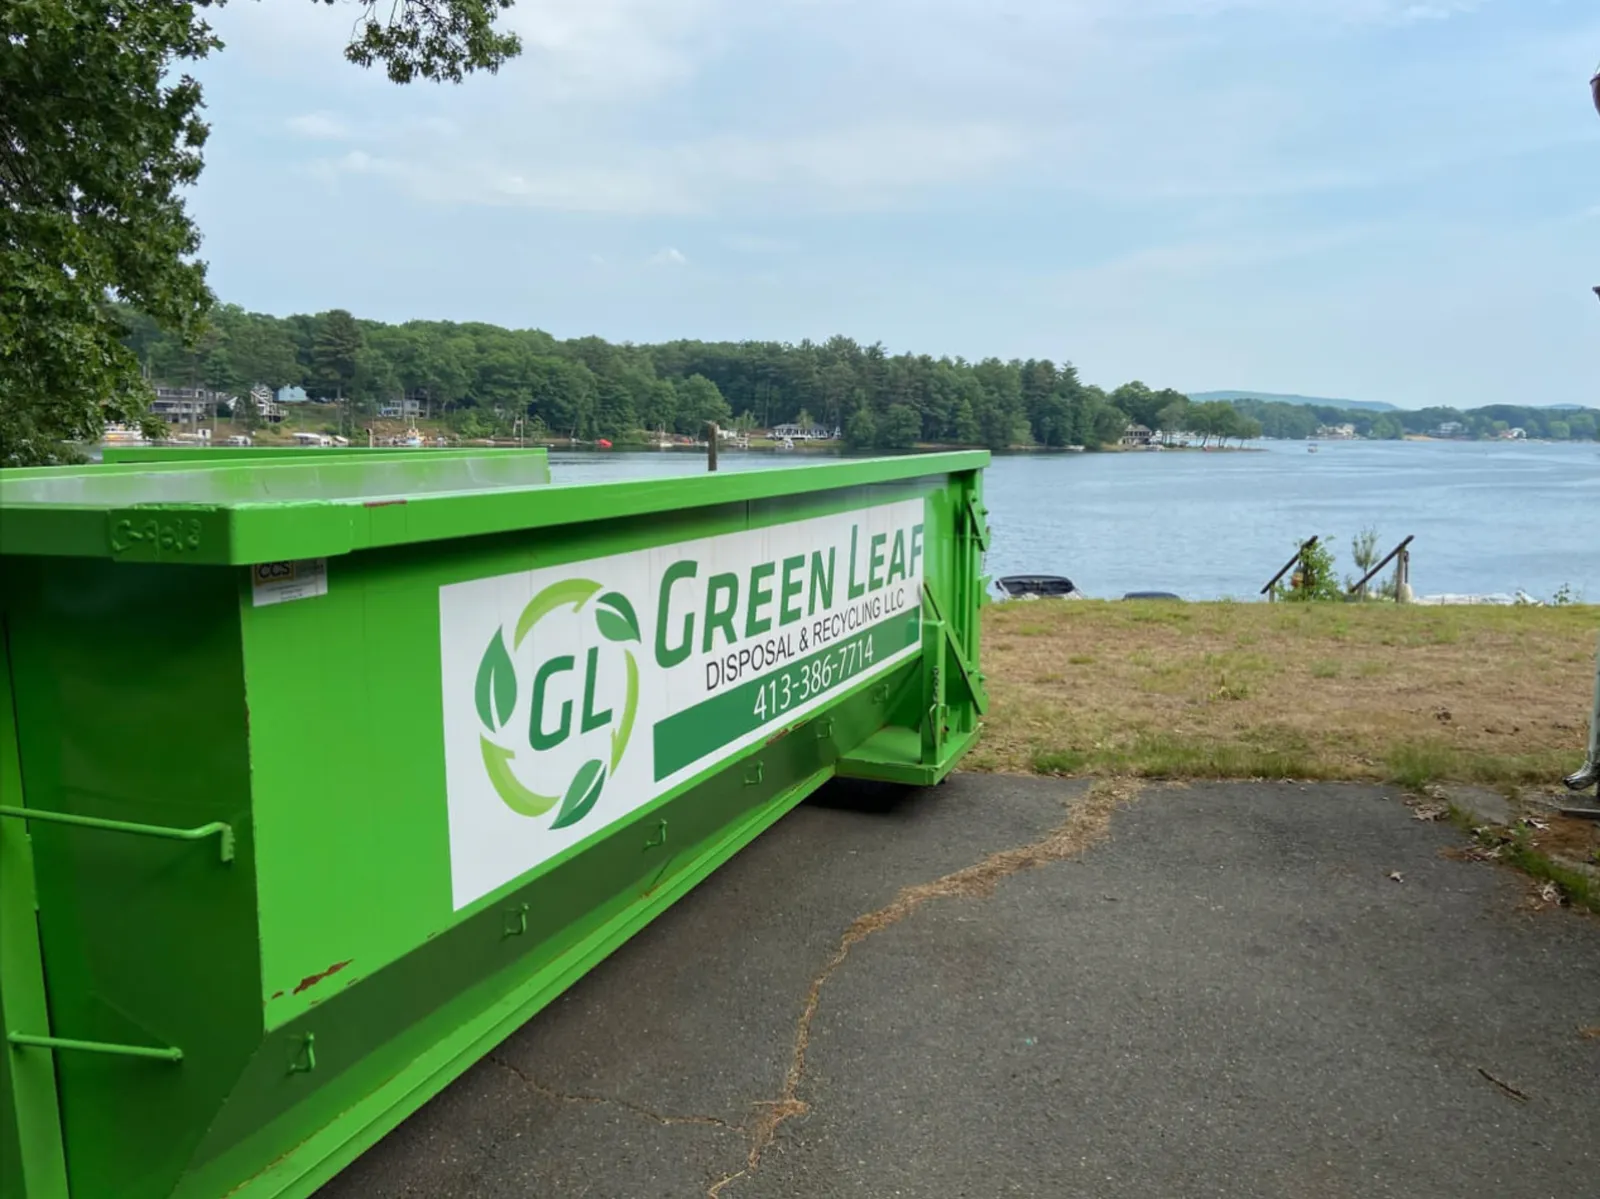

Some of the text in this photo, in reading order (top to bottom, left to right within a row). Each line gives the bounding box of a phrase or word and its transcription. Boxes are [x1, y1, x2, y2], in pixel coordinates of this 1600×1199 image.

[705, 588, 906, 691] DISPOSAL & RECYCLING LLC
[753, 633, 874, 721] 413-386-7714
[528, 646, 613, 752] GL
